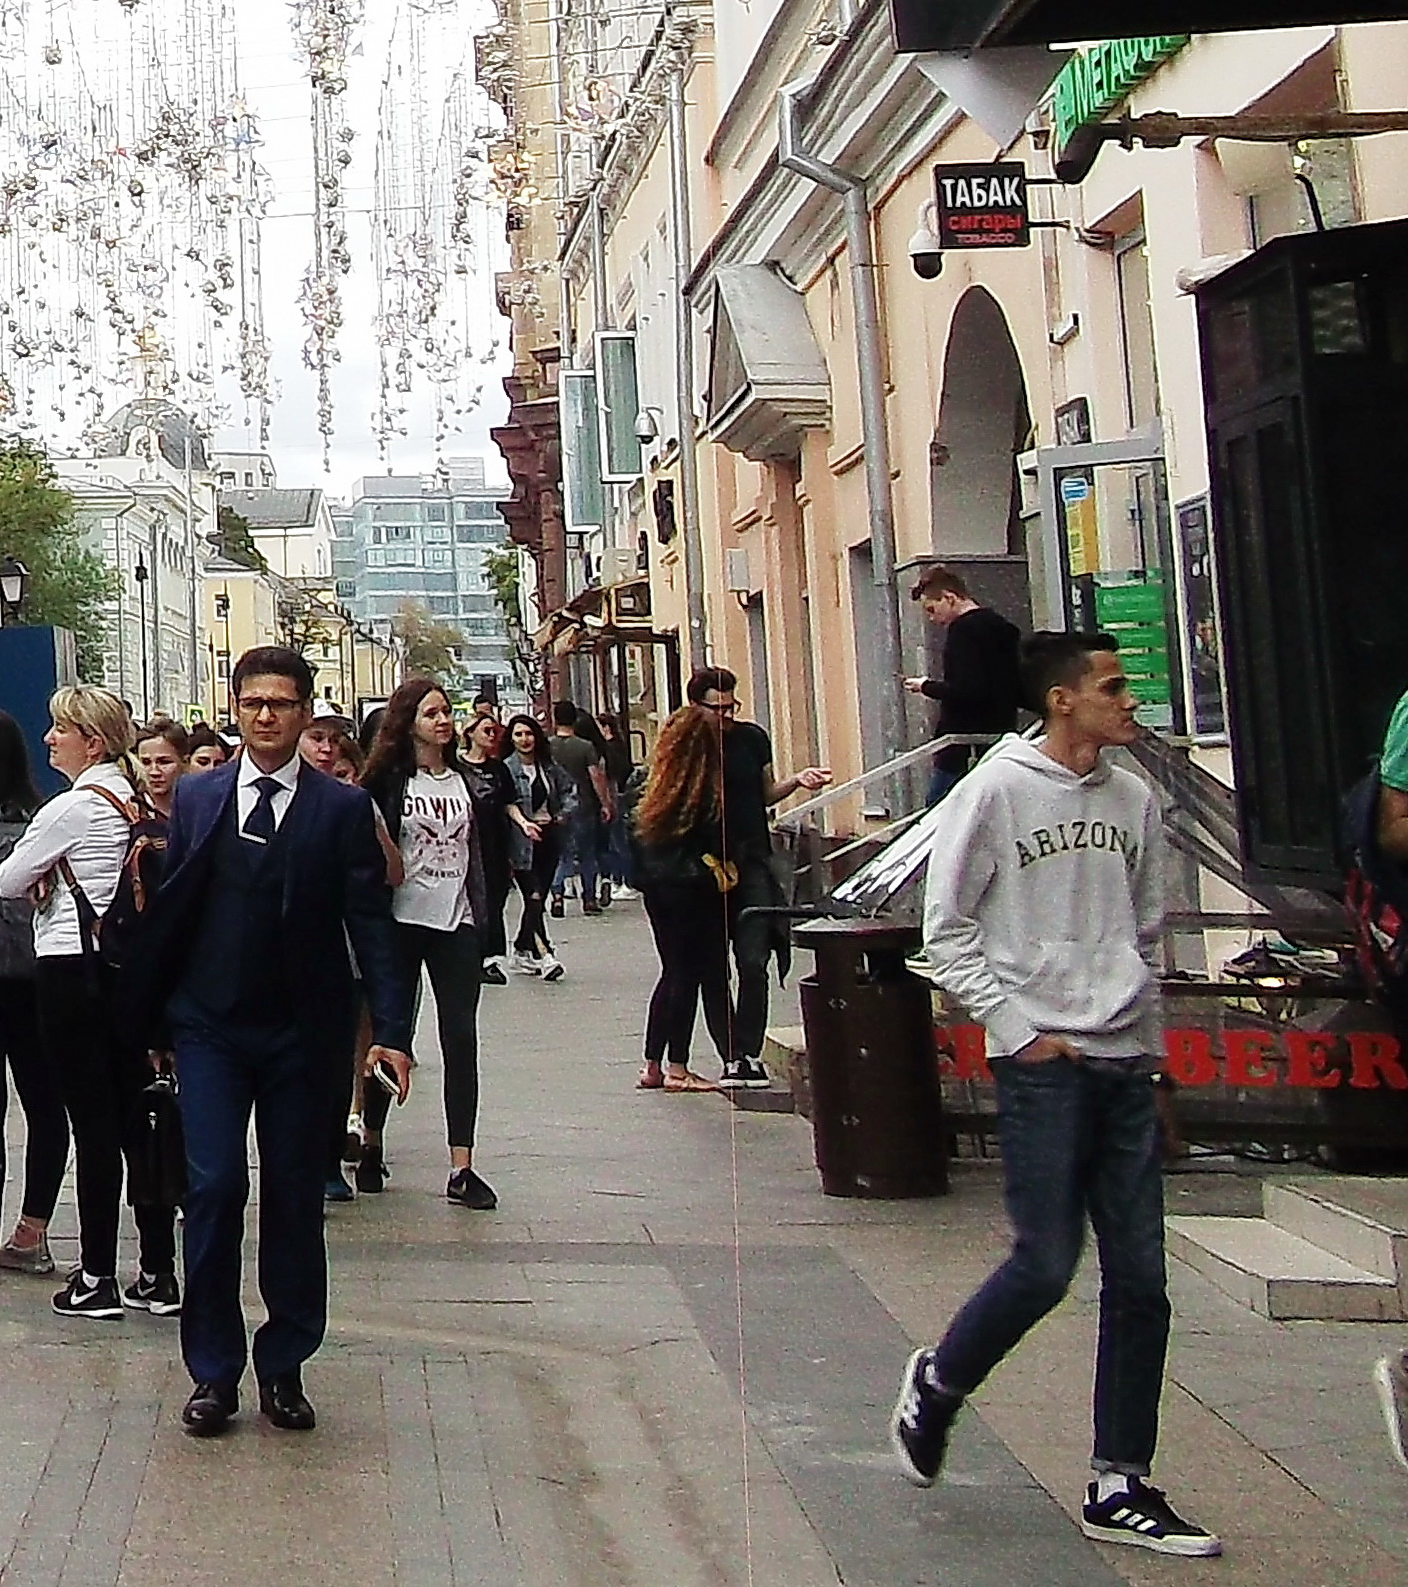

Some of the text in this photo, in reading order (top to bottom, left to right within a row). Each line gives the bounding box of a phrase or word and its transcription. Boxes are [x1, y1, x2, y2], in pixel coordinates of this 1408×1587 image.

[940, 176, 1023, 208] ТАБАК
[1015, 820, 1140, 869] ARIZONA
[1162, 1028, 1407, 1090] BEER
